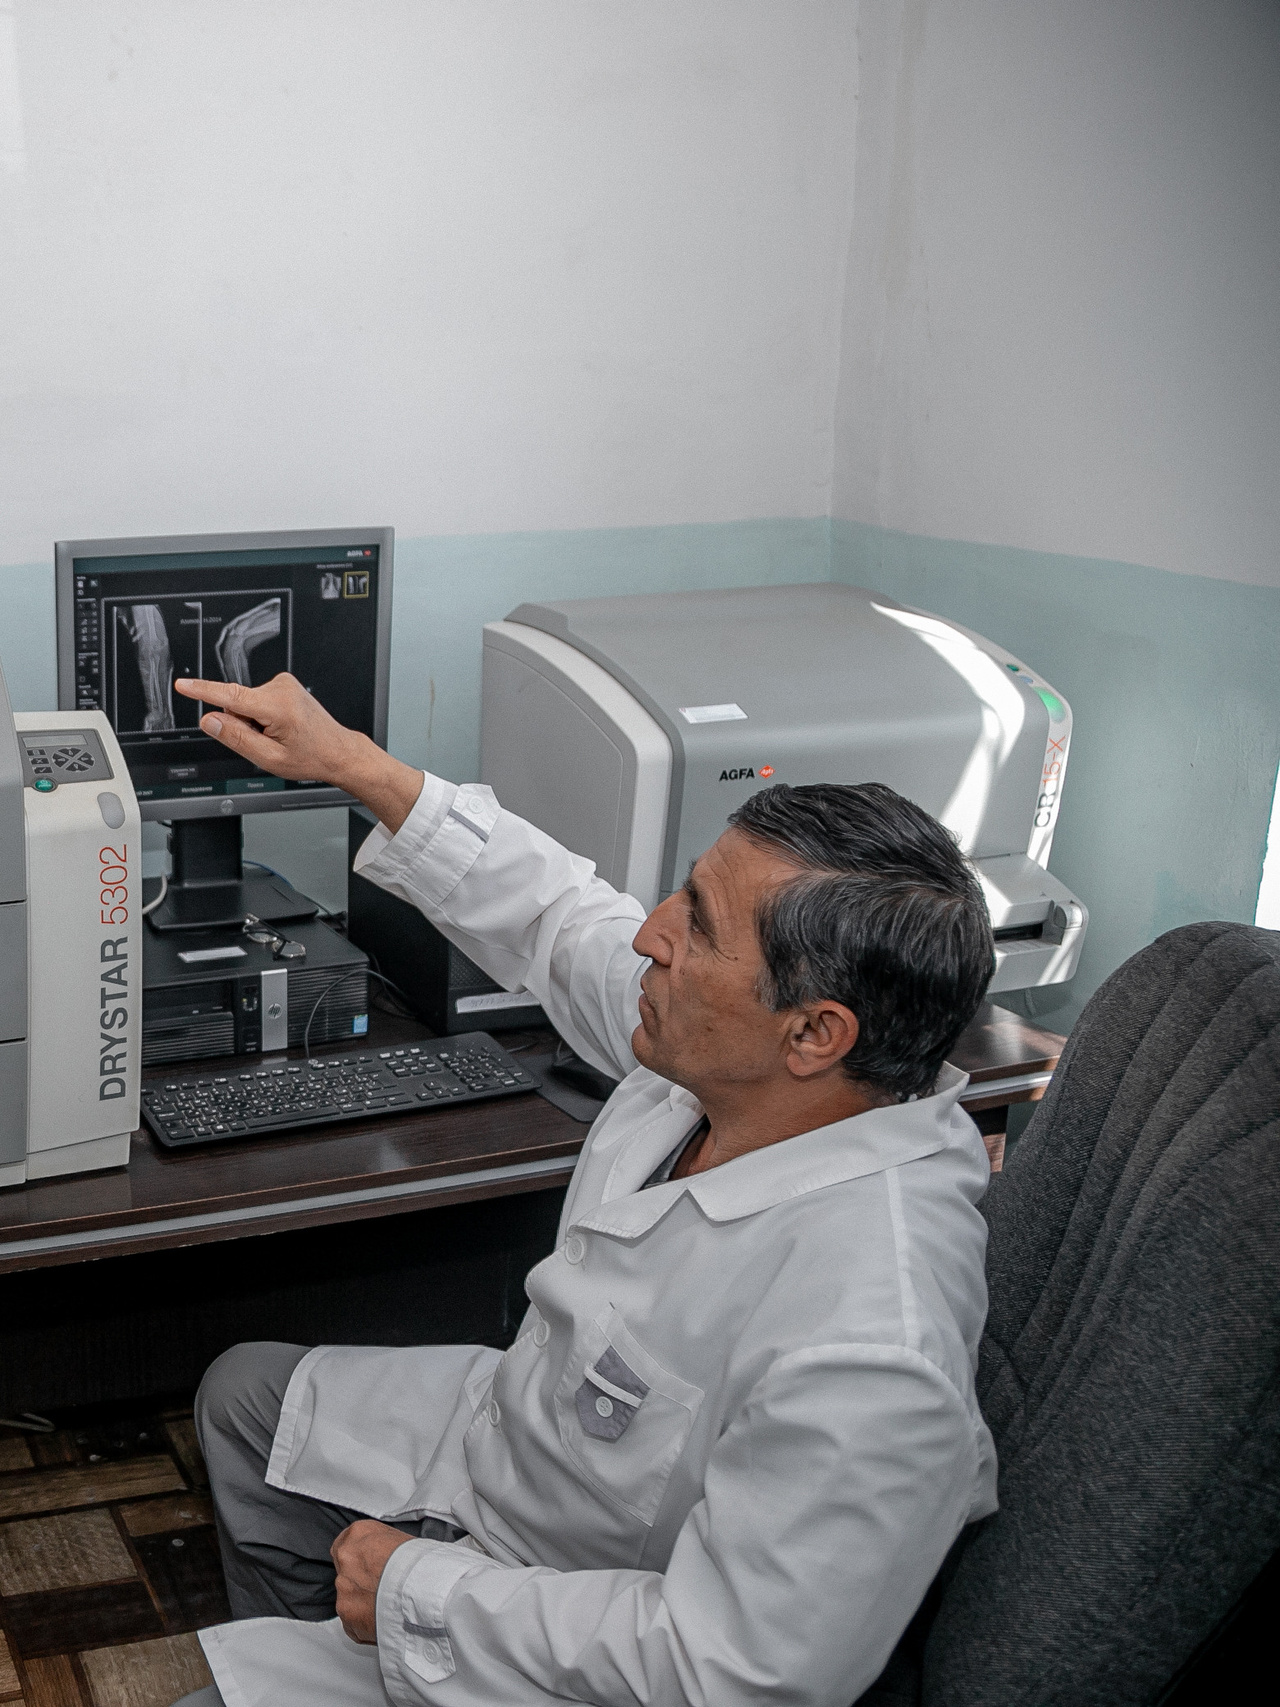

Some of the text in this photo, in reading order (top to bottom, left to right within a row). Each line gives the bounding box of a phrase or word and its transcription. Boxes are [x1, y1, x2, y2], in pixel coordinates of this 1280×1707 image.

[718, 767, 755, 782] AGFA
[98, 843, 129, 1101] DRYSTAR 5302
